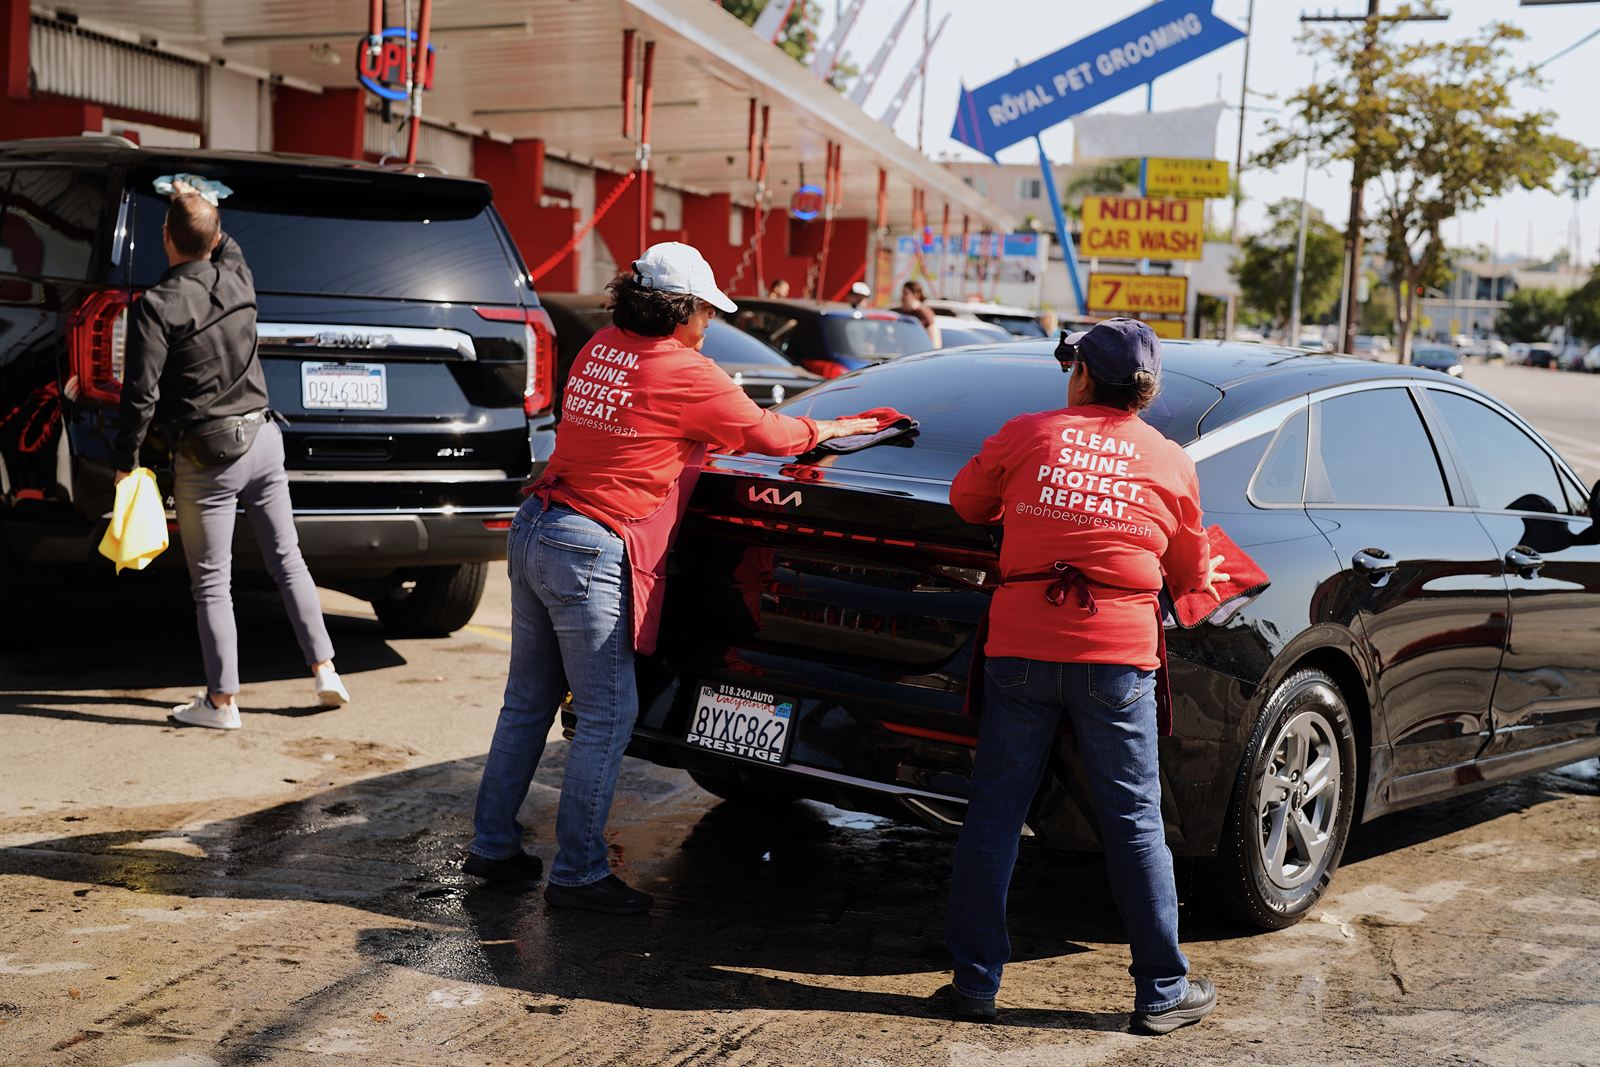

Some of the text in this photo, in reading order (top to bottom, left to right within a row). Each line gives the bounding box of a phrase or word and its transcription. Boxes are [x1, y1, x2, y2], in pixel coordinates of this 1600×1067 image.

[988, 12, 1203, 127] ROYAL PET GROOMING
[1099, 198, 1188, 223] NOHO
[1087, 228, 1198, 254] CAR WASH
[1126, 293, 1181, 307] WASH
[590, 344, 640, 370] CLEAN.
[582, 361, 629, 387] SHINE.
[309, 381, 379, 402] 09463U3
[567, 376, 634, 408] PROTECT.
[565, 394, 618, 422] REPEAT.
[1061, 428, 1141, 460] CLEAN.
[1058, 447, 1135, 478] SHINE.
[748, 485, 803, 507] KIA
[1037, 464, 1144, 504] PROTECT.
[1039, 486, 1133, 520] REPEAT.
[1016, 502, 1152, 538] @nohoexpresswash
[720, 684, 774, 704] 818.240.AUTO
[696, 706, 785, 752] 8YXC862
[686, 733, 782, 763] PRESTIGE
